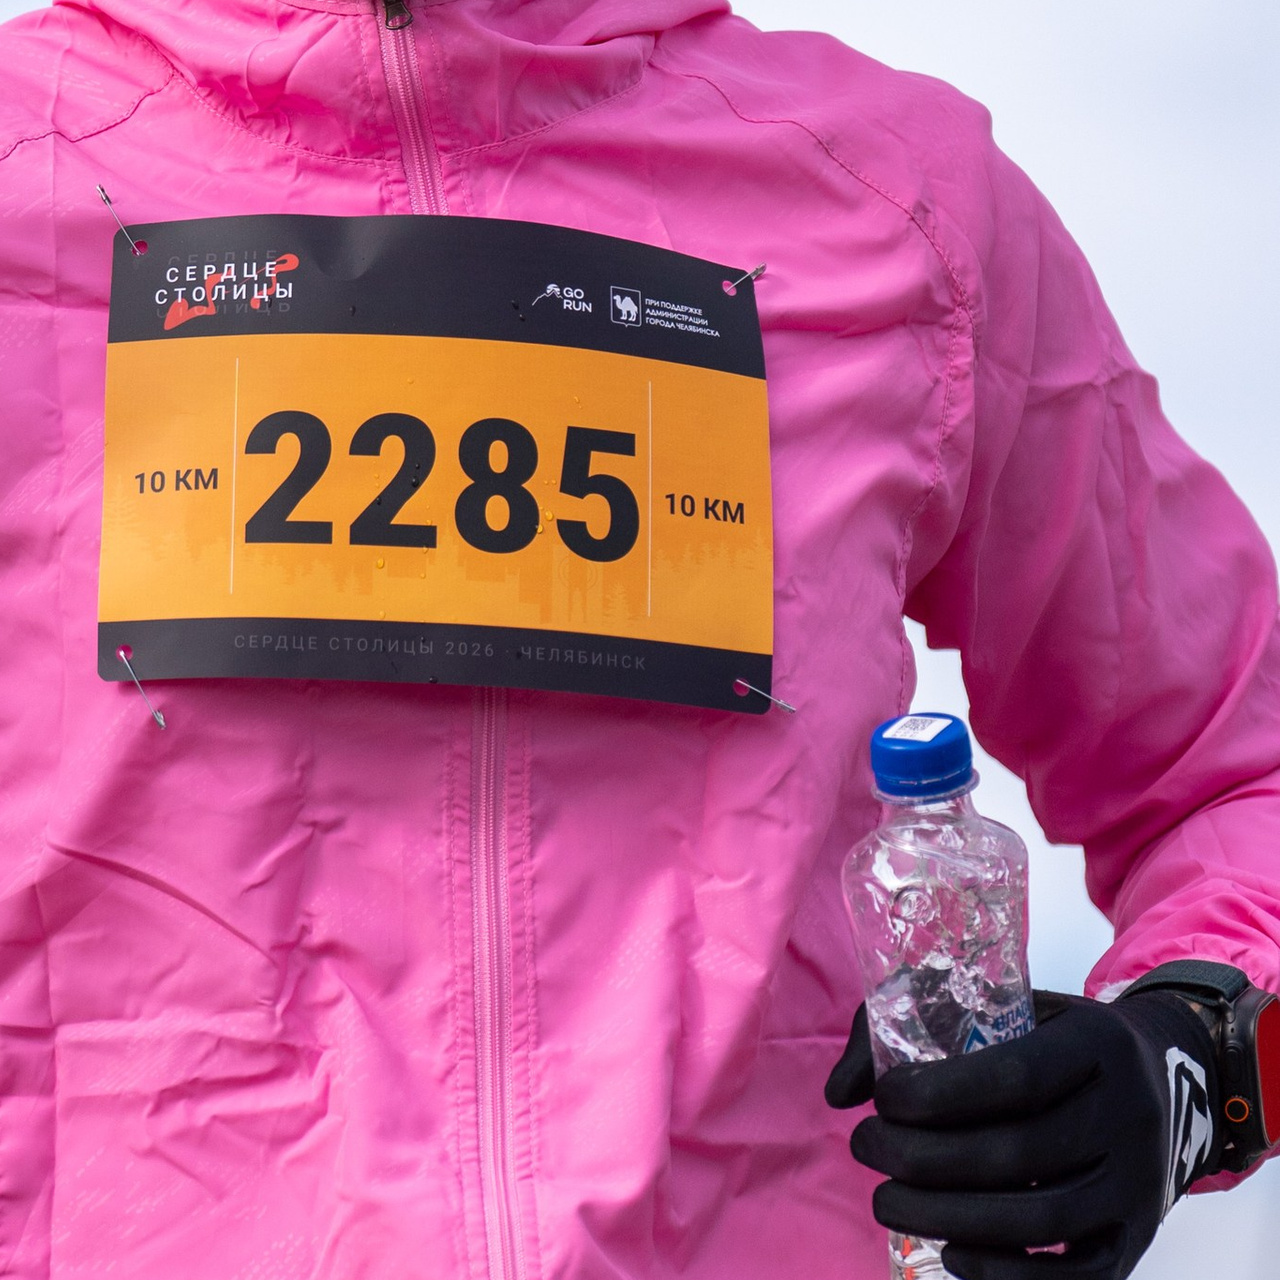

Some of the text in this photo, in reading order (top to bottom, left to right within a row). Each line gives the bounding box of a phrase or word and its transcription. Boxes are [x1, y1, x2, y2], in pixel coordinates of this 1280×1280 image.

[166, 261, 278, 283] СЕРДЦЕ
[154, 282, 294, 305] СТОЛИЦЫ
[563, 287, 585, 300] GO
[563, 299, 593, 313] RUN
[645, 298, 703, 317] ПРИ ПОДДЕРЖКЕ
[645, 308, 709, 327] АДМИНИСТРАЦИИ
[645, 317, 721, 339] ГОРОДА ЧЕЛЯБИНСКА
[134, 470, 166, 495] 10
[243, 409, 641, 564] 2285
[665, 493, 696, 517] 10
[233, 634, 647, 671] СЕРДЦЕ СТОЛИЦЫ 2026 ЧЕЛЯБИНСК
